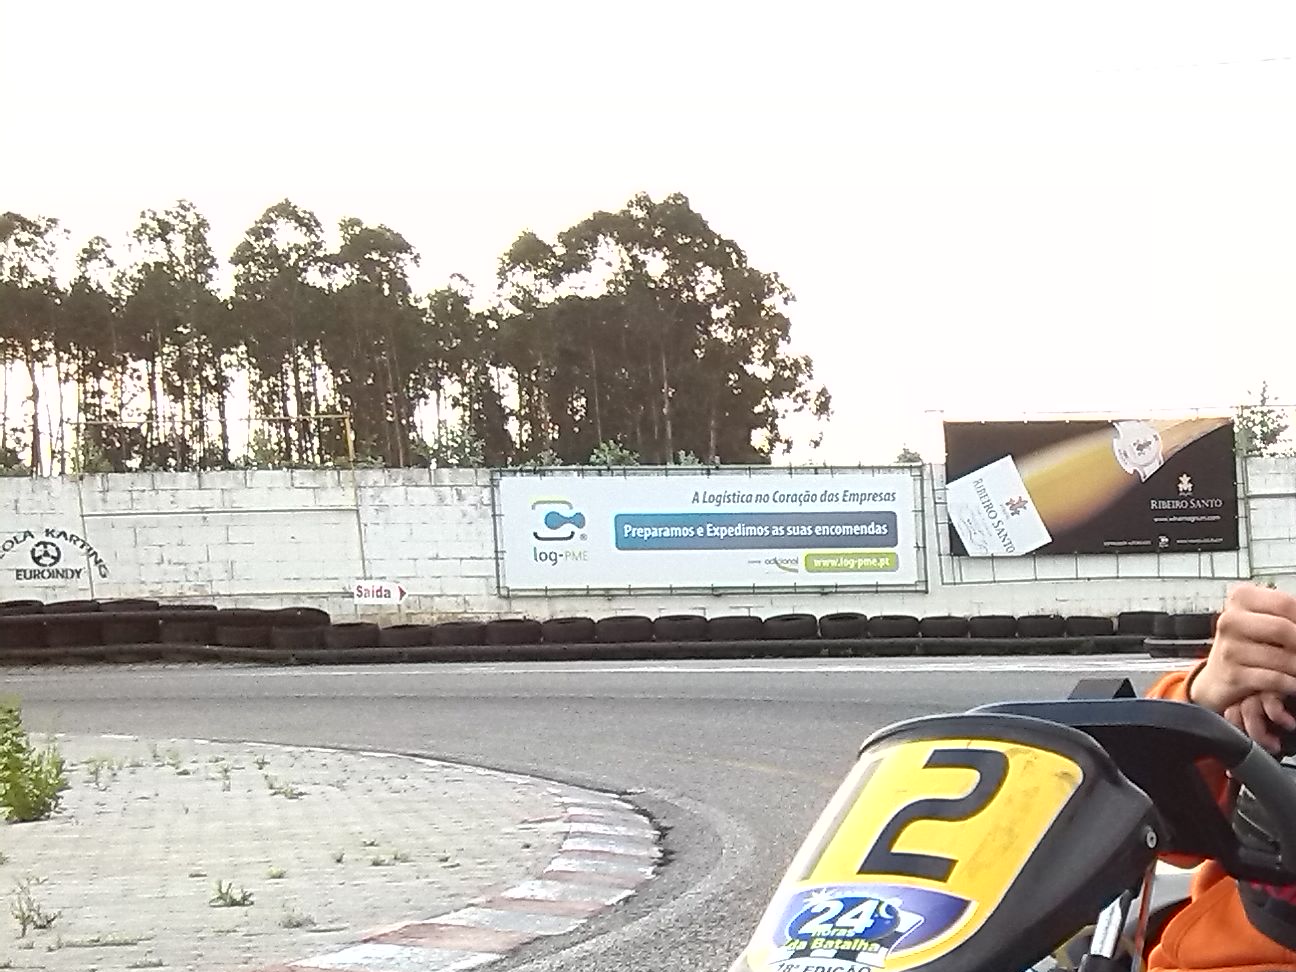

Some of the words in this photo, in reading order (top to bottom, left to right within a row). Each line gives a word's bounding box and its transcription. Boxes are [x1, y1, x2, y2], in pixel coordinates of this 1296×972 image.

[692, 491, 699, 504] A
[702, 490, 752, 507] Logística
[755, 493, 769, 504] no
[772, 490, 817, 506] Coração
[820, 490, 839, 503] das
[842, 490, 896, 505] Empresas
[1150, 499, 1189, 510] RIBEIRO
[1190, 498, 1223, 509] SANTO
[973, 478, 997, 519] RIBEIRO
[992, 520, 1016, 554] SANTO
[623, 524, 694, 540] Preparamos
[697, 526, 704, 536] e
[706, 523, 769, 539] Expedimos
[772, 526, 785, 536] as
[786, 525, 812, 536] suas
[814, 522, 888, 536] encomendas
[0, 530, 35, 559] OLA
[45, 528, 110, 578] KARTING
[813, 557, 890, 569] www.log-pme.pt
[16, 567, 82, 580] EUROINDY
[857, 748, 1010, 884] 2
[798, 899, 880, 934] 24
[810, 937, 881, 953] Batalha
